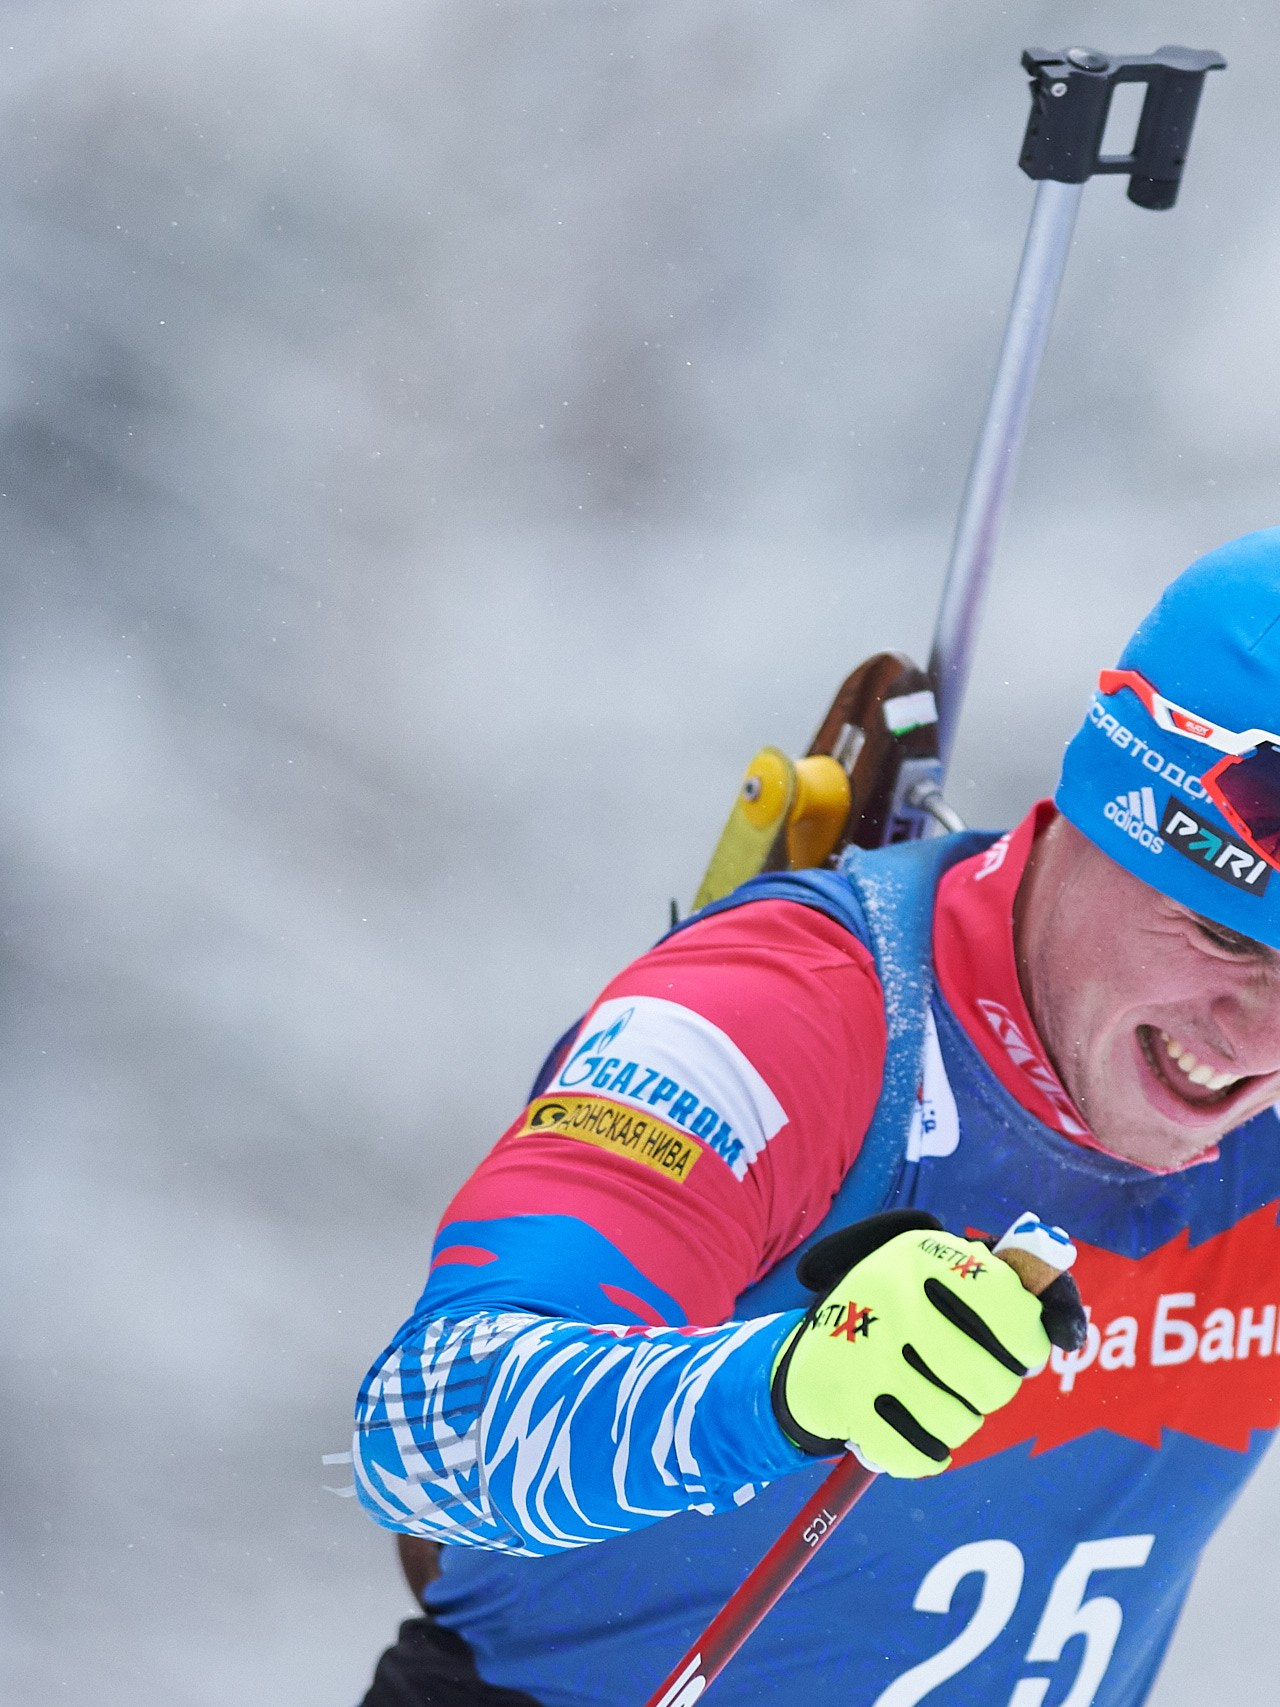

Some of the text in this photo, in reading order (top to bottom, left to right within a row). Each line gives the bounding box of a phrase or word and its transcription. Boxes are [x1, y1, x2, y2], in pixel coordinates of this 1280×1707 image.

[1103, 801, 1165, 855] adidas
[1165, 810, 1268, 885] PARI
[591, 1056, 745, 1168] GAZPROM
[641, 1126, 692, 1177] НИВА
[872, 1534, 1156, 1707] 25
